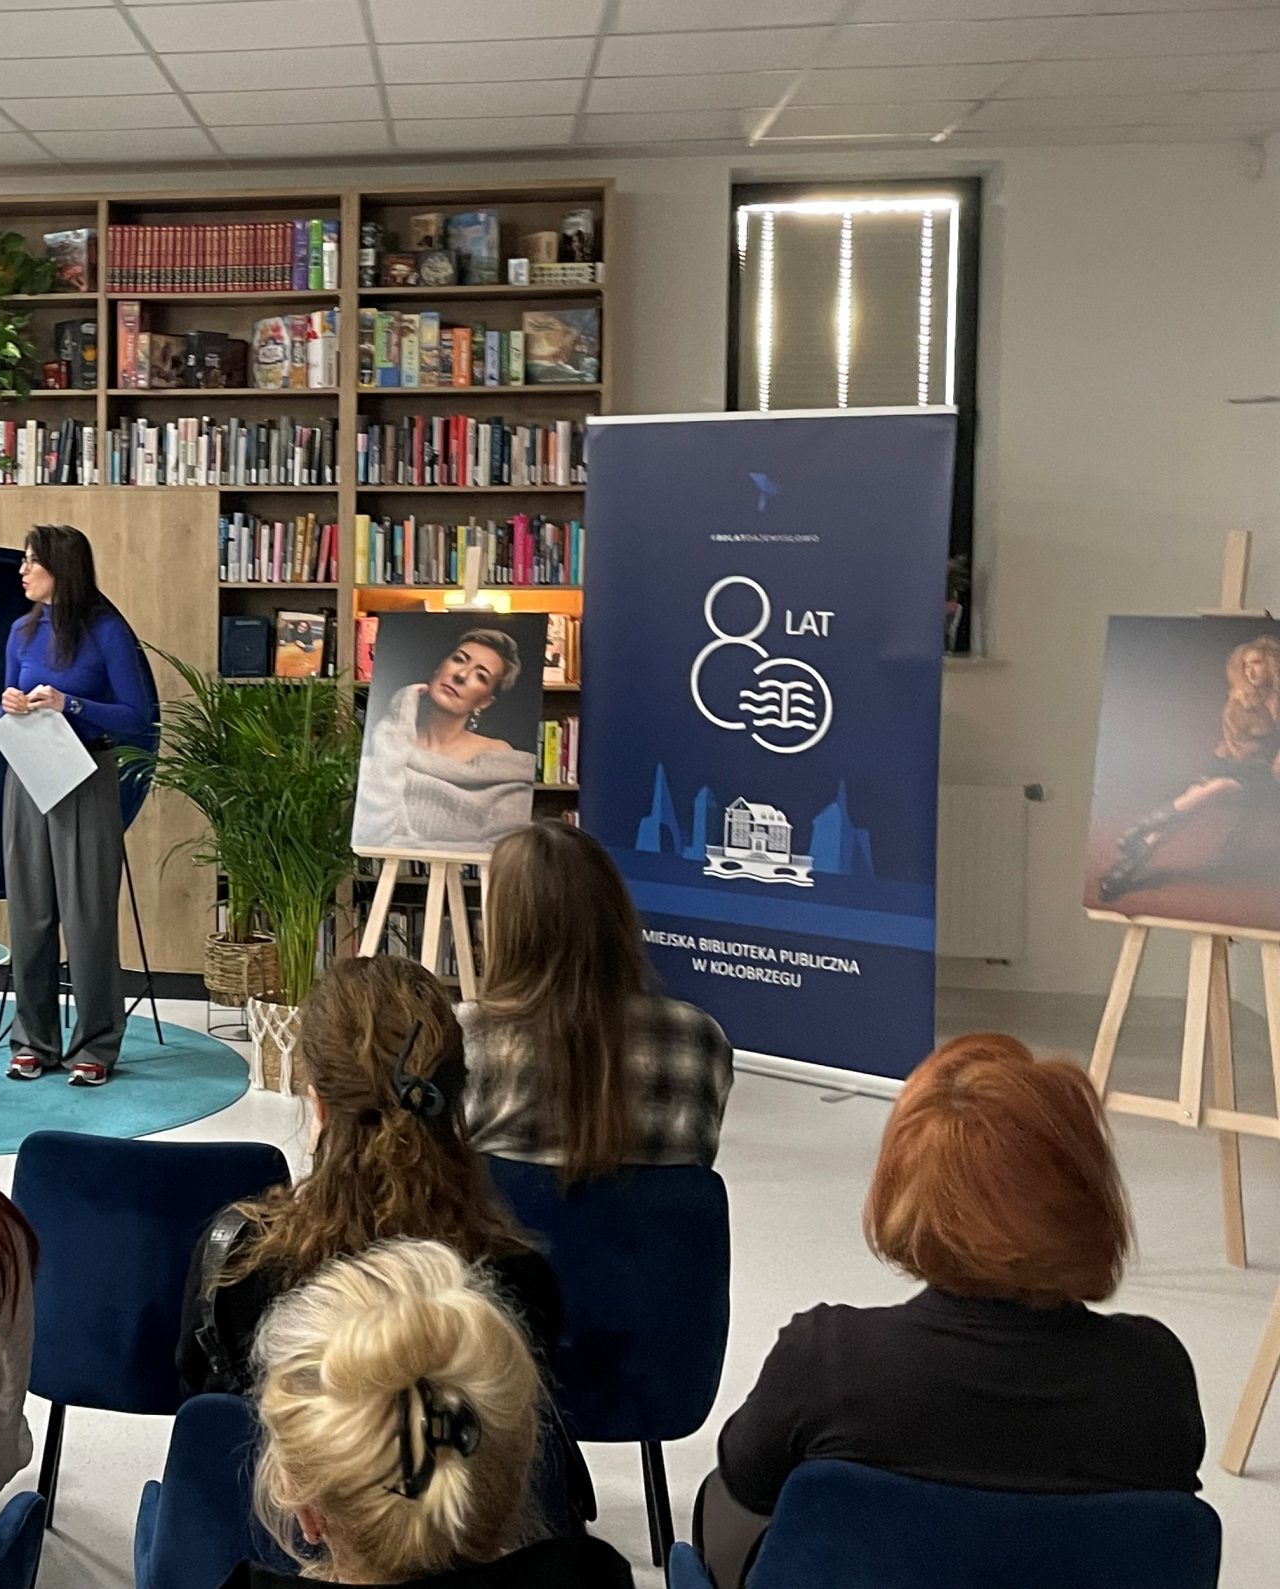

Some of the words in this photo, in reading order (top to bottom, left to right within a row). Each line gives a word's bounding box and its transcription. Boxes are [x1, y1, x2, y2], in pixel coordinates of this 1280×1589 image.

[785, 609, 835, 637] LAT
[641, 929, 697, 951] MIEJSKA
[698, 937, 777, 962] BIBLIOTEKA
[779, 949, 861, 976] PUBLICZNA
[692, 957, 708, 973] W
[709, 960, 802, 988] KOŁOBRZEGU
